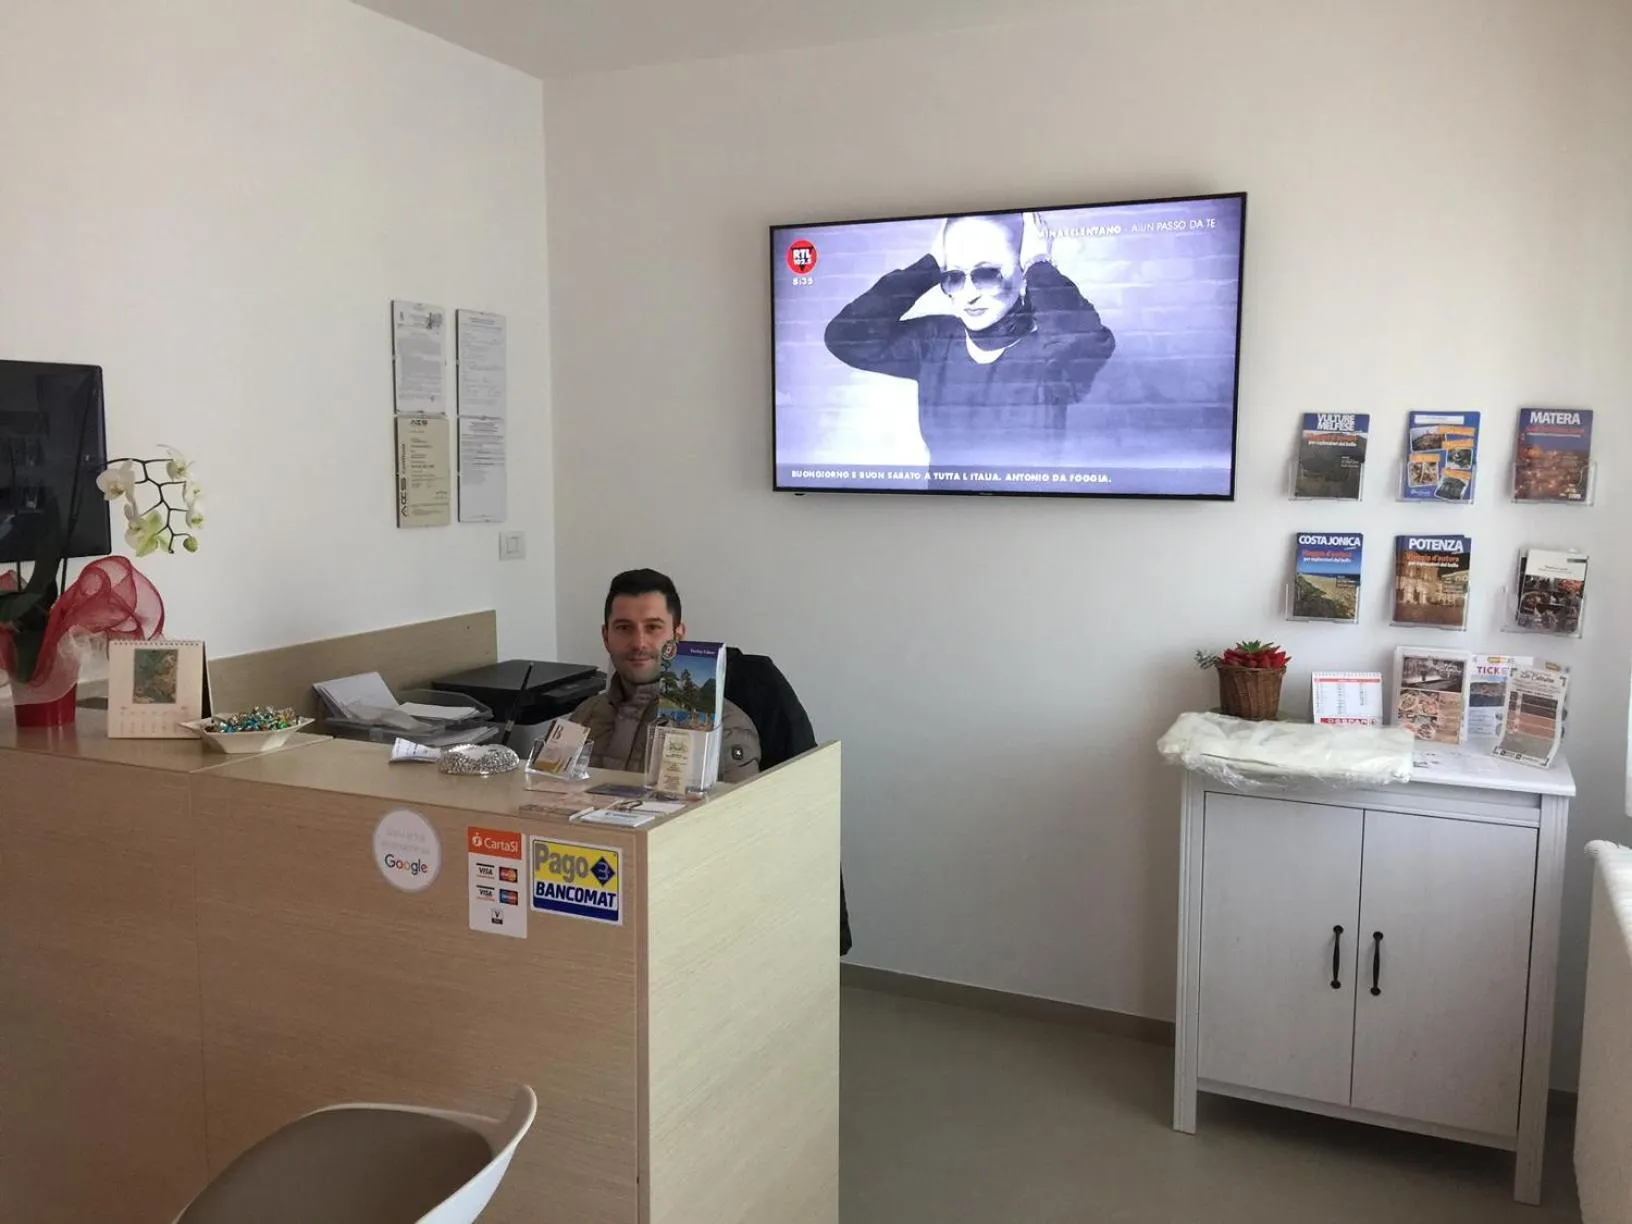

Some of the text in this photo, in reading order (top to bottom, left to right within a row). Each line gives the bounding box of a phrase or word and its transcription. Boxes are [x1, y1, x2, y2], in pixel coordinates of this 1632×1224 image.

[1157, 219, 1187, 231] PASSO
[1189, 218, 1204, 230] DA
[1205, 217, 1217, 229] TE
[793, 248, 812, 260] RTL
[1530, 411, 1581, 426] MATERA
[859, 471, 885, 480] BUON
[888, 471, 921, 481] SABATO
[924, 472, 931, 481] A
[933, 472, 961, 481] TUTTA
[1005, 472, 1049, 482] ANTONIO
[1052, 473, 1068, 483] DA
[1409, 538, 1464, 553] POTENZA
[384, 853, 428, 876] Google
[535, 843, 589, 883] Pago
[479, 867, 493, 876] VISA
[479, 889, 493, 897] VISA
[536, 881, 617, 908] BANCOMAT
